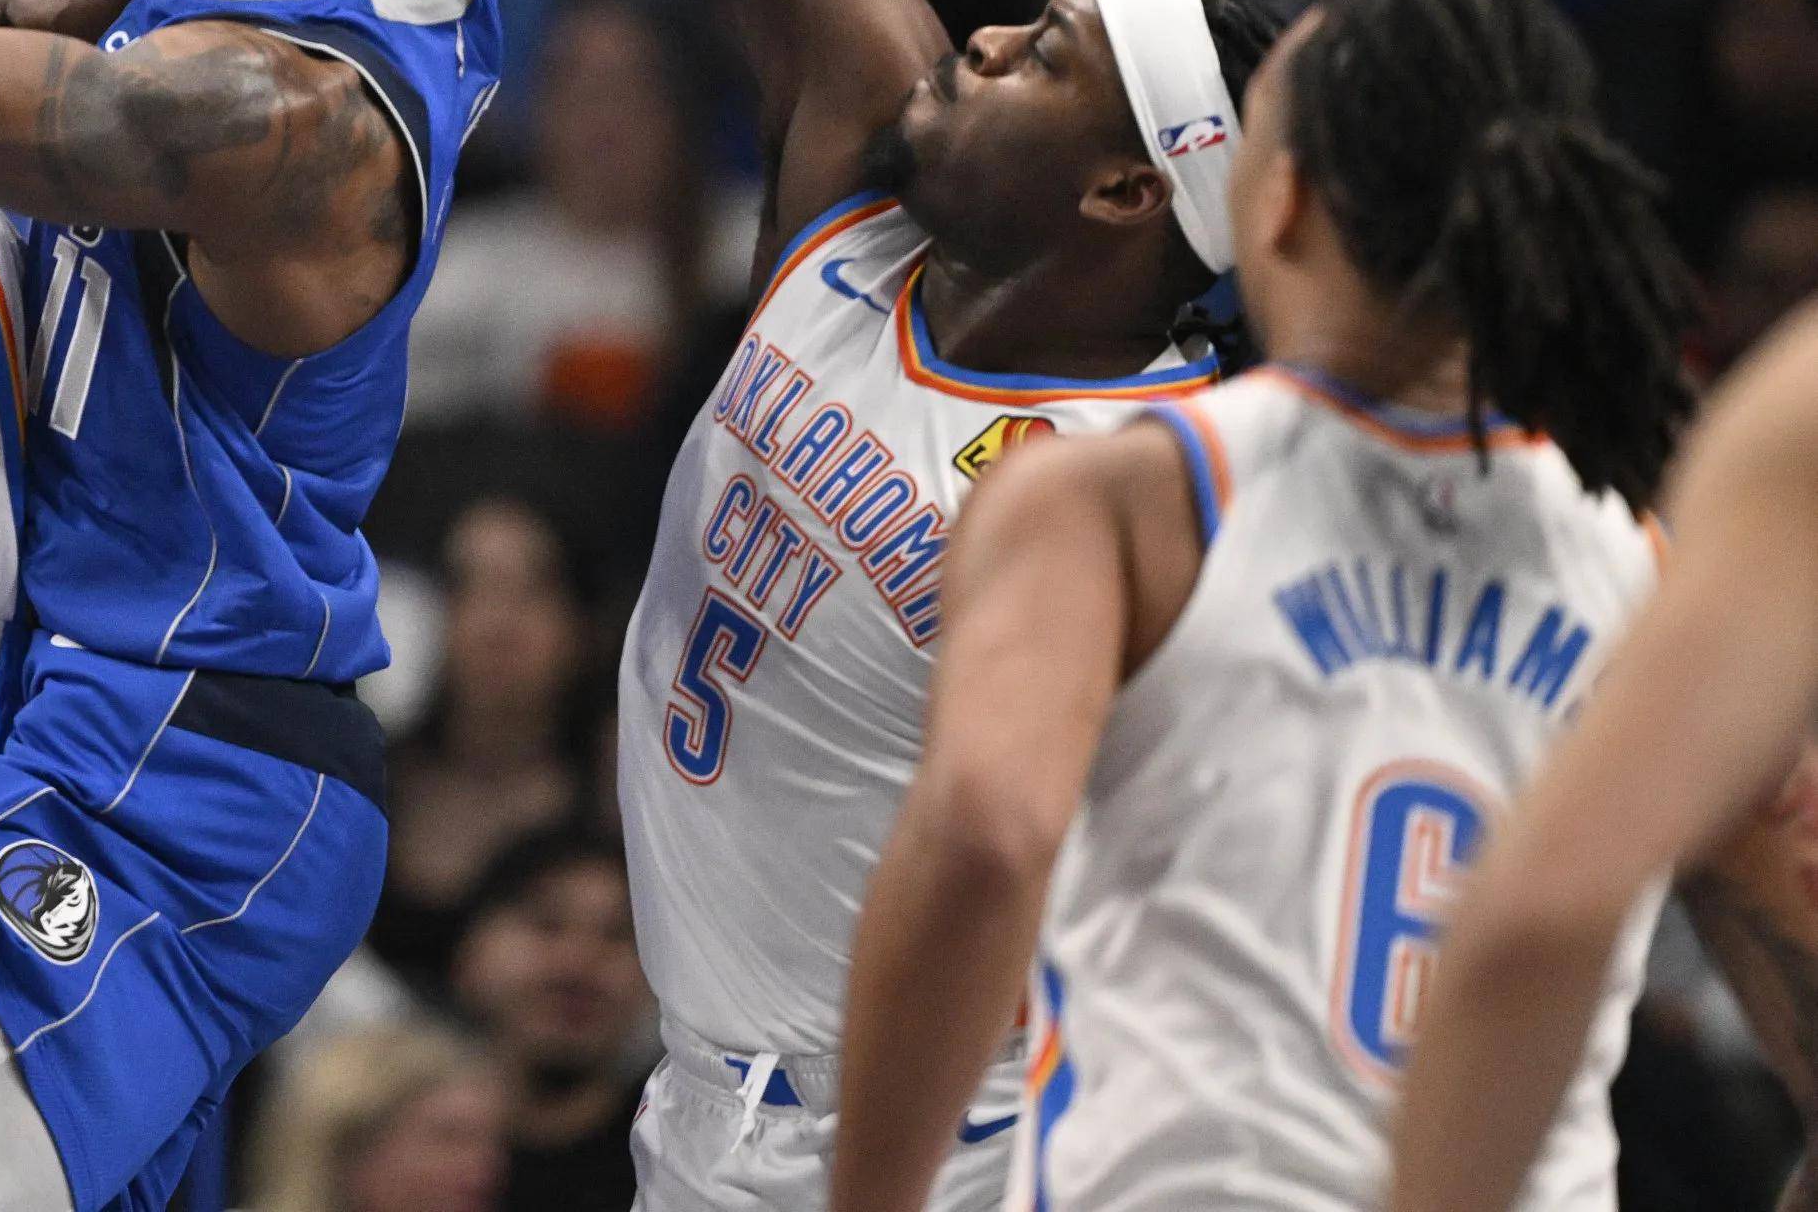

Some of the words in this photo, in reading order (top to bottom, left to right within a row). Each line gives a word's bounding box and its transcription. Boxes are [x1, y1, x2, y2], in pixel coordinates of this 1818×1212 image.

[29, 234, 112, 440] 11
[703, 474, 844, 641] CITY
[1274, 554, 1591, 710] WILLIAM
[663, 587, 767, 785] 5
[1330, 758, 1502, 1090] 6
